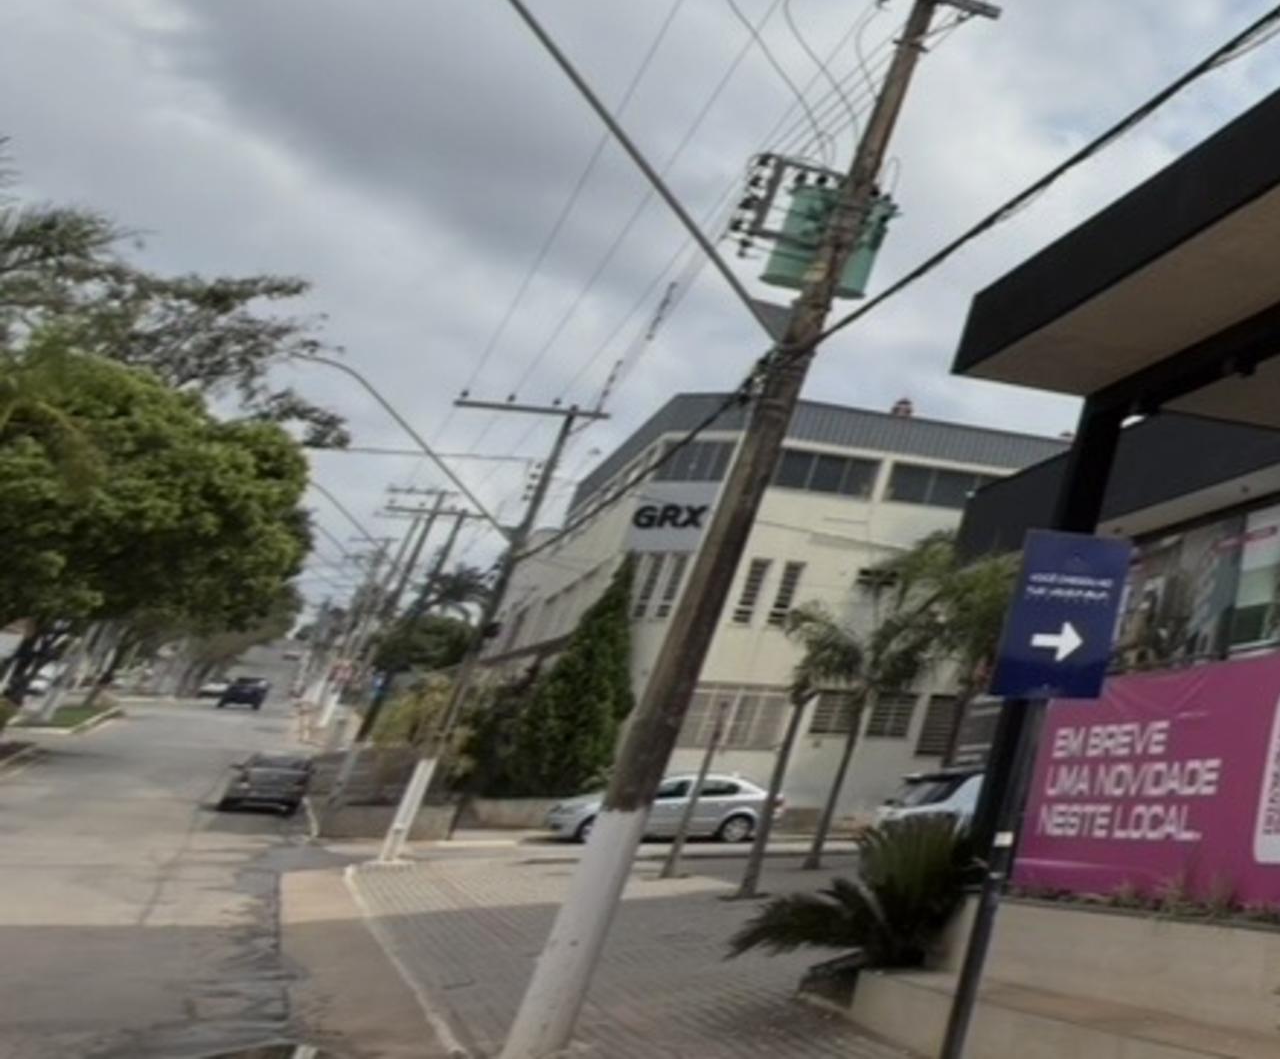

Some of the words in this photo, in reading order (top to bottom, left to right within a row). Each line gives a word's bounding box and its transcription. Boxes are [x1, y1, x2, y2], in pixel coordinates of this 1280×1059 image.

[632, 503, 707, 529] GRX
[1052, 727, 1085, 758] EM
[1086, 721, 1170, 757] BREVE
[1046, 764, 1090, 796] UMA
[1094, 758, 1222, 796] NOVIDADE
[1037, 803, 1112, 838] NESTE
[1112, 804, 1202, 840] LOCAL.
